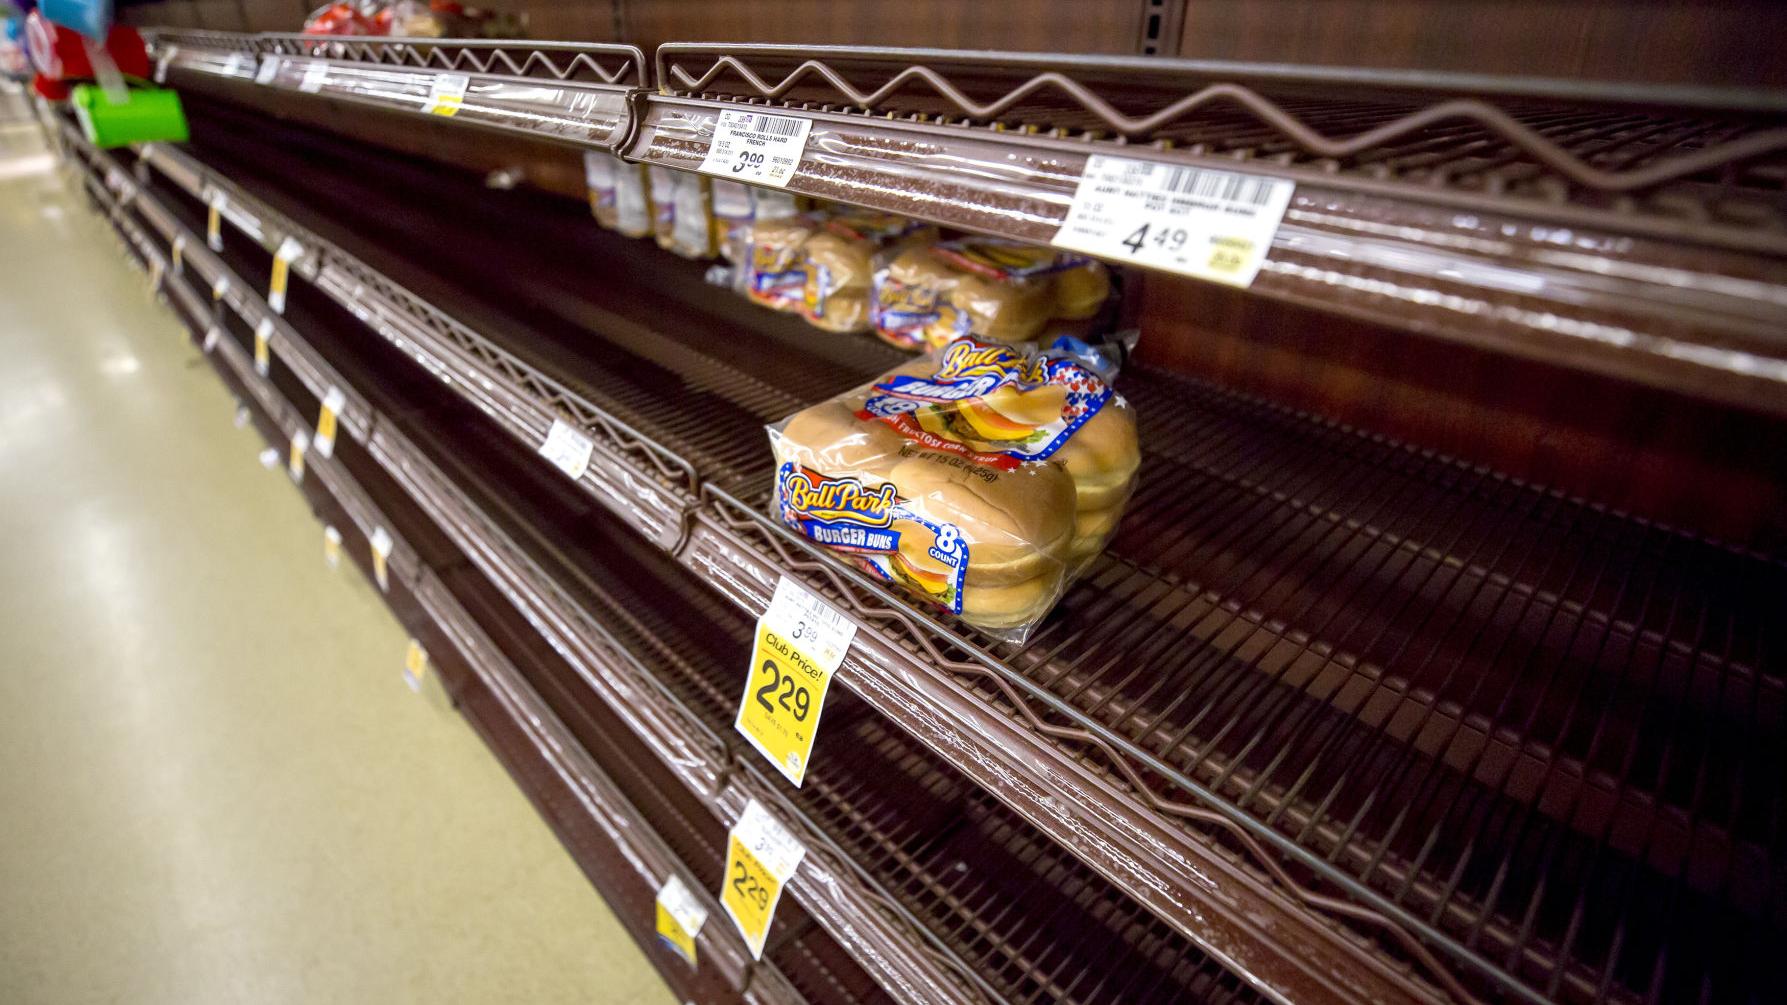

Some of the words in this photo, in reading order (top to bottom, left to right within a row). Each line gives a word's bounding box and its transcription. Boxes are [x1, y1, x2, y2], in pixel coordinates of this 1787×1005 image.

[730, 130, 756, 139] FRANCISCO
[732, 151, 765, 172] 399
[1122, 223, 1188, 253] 449
[940, 344, 1008, 378] Ball
[935, 455, 948, 464] 15
[788, 477, 837, 513] Ball
[836, 482, 892, 515] Park
[813, 525, 866, 546] BURGER
[866, 533, 893, 550] BUNS
[936, 523, 959, 553] 8
[929, 548, 957, 567] COUNT
[766, 633, 789, 656] Club
[790, 651, 823, 682] Price!
[756, 659, 810, 722] 229
[733, 861, 769, 911] 229
